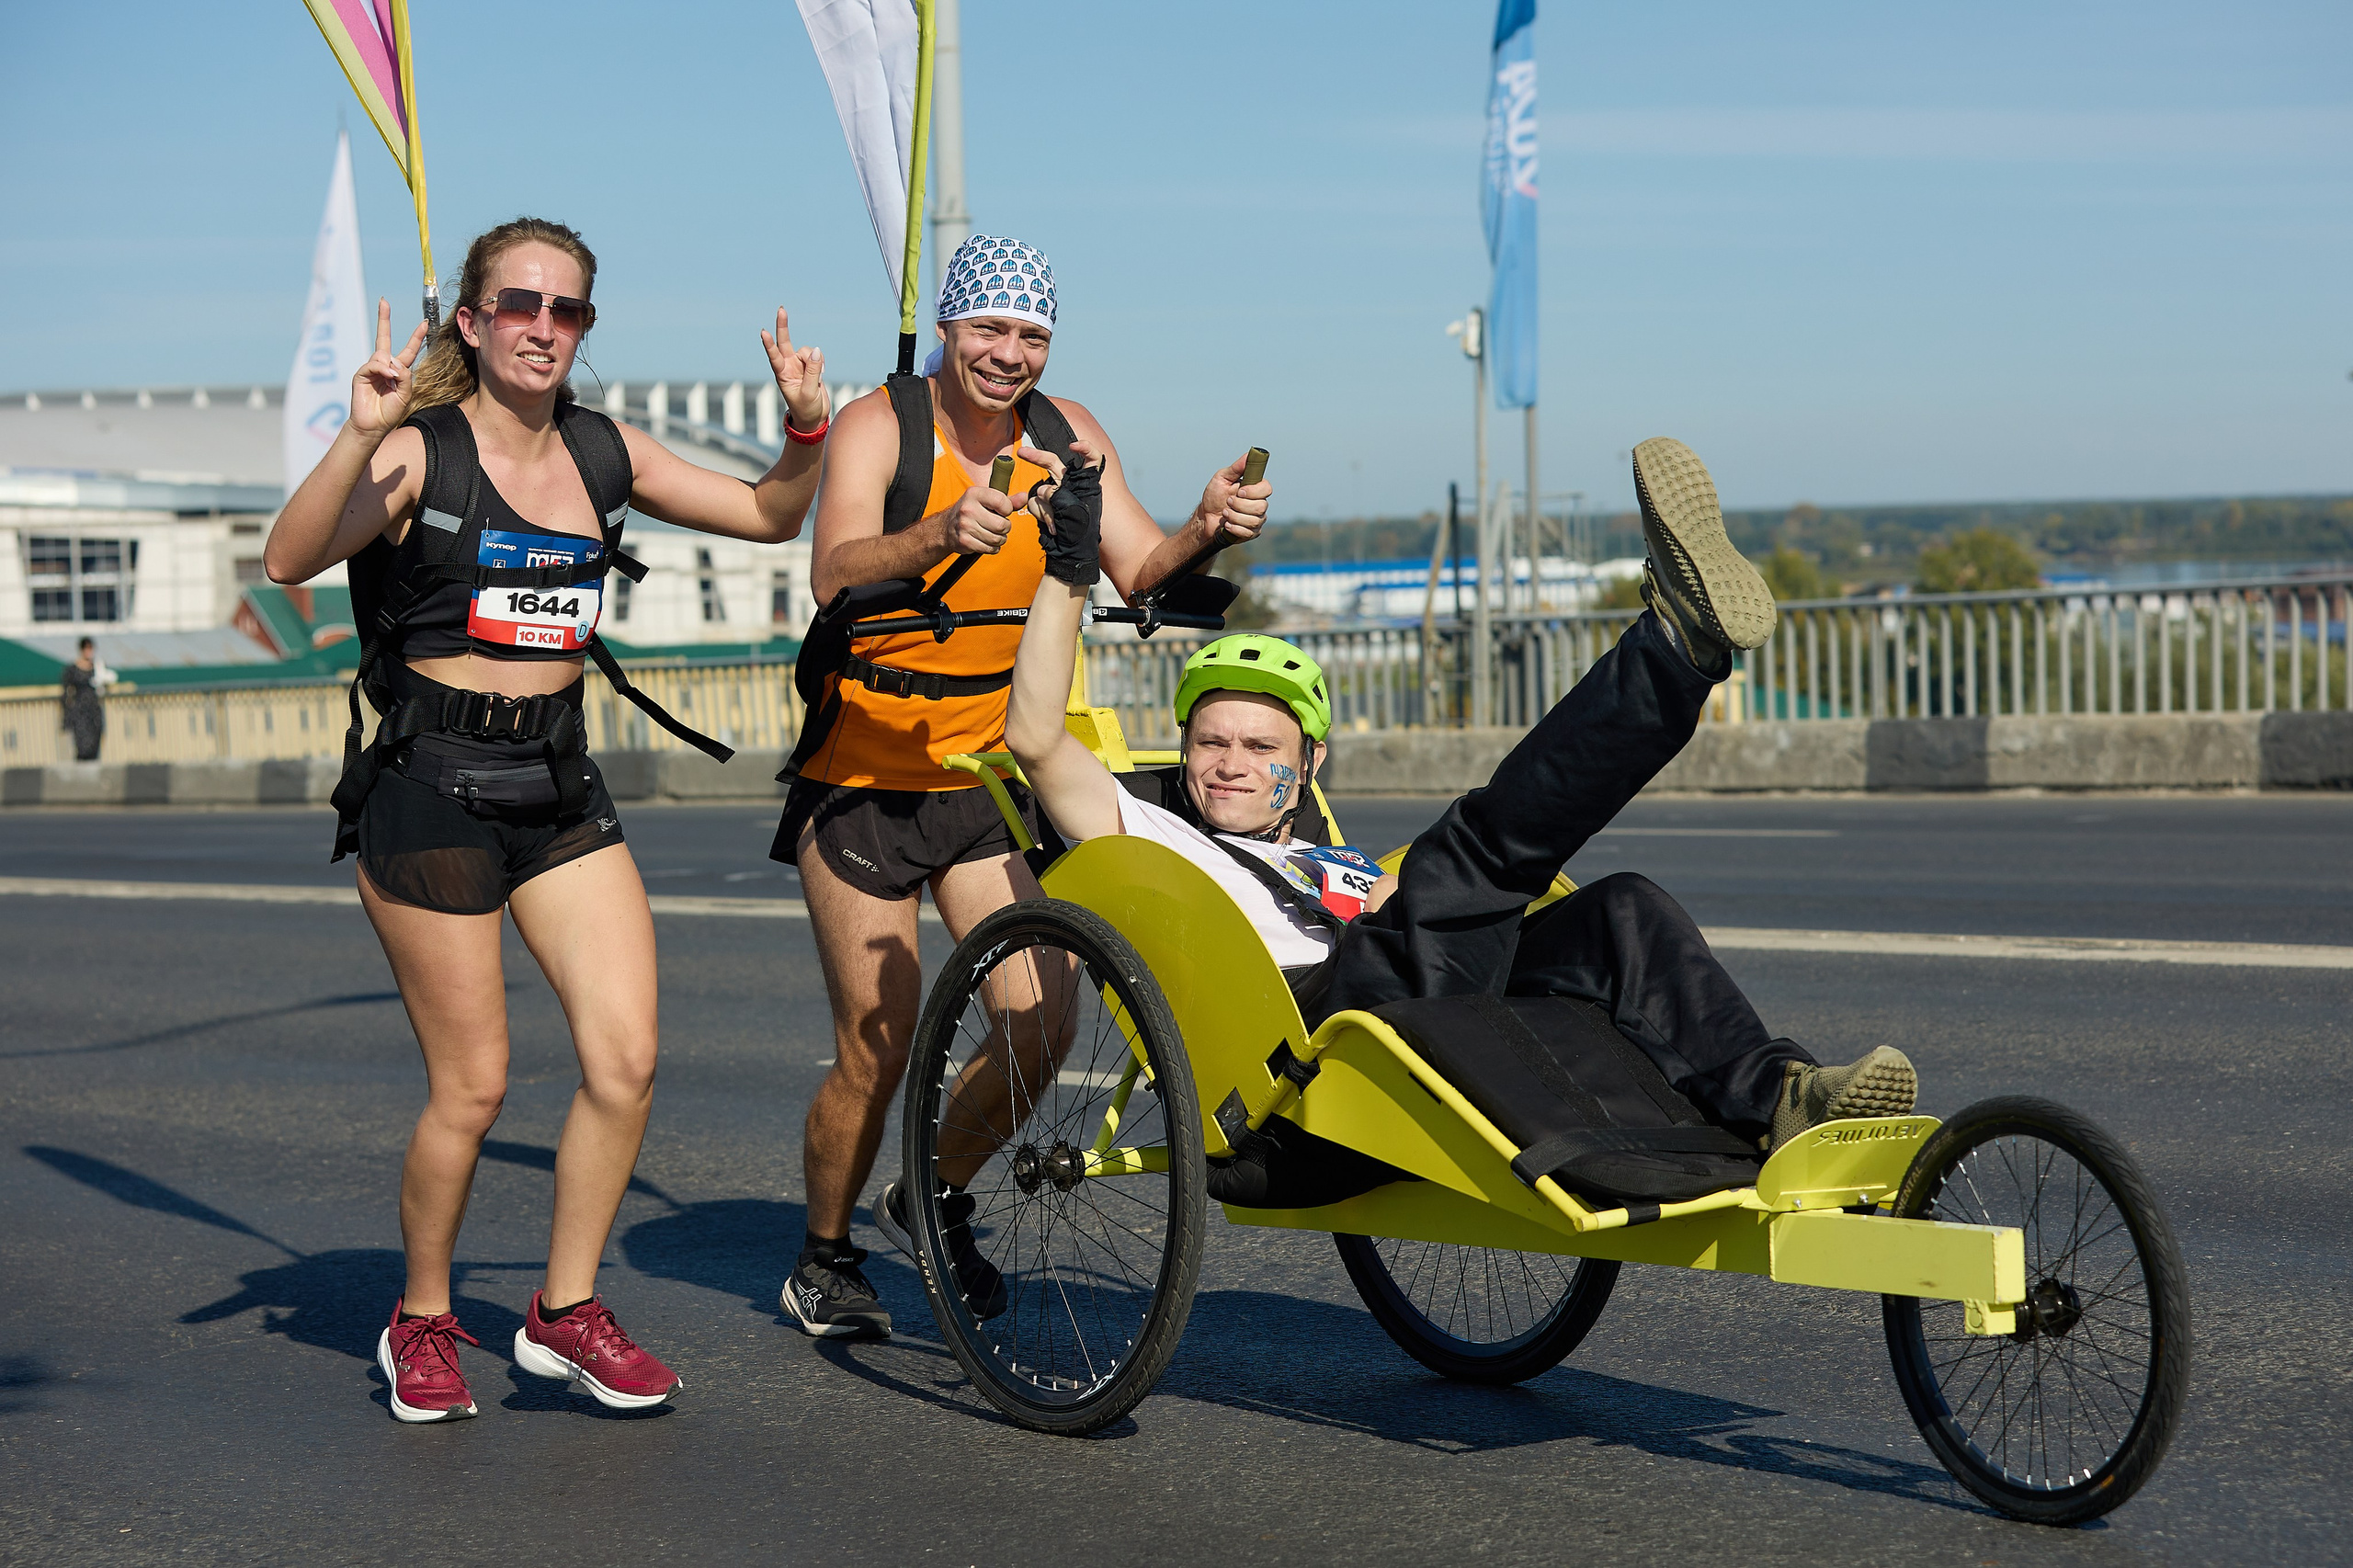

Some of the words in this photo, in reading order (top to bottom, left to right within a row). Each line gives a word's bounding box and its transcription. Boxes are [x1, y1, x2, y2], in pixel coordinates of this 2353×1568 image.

[507, 592, 580, 619] 1644
[996, 608, 1029, 617] 4BIKE
[518, 631, 535, 642] 10
[579, 624, 587, 637] D
[842, 848, 873, 869] CRAFT
[918, 1249, 938, 1294] KENDA
